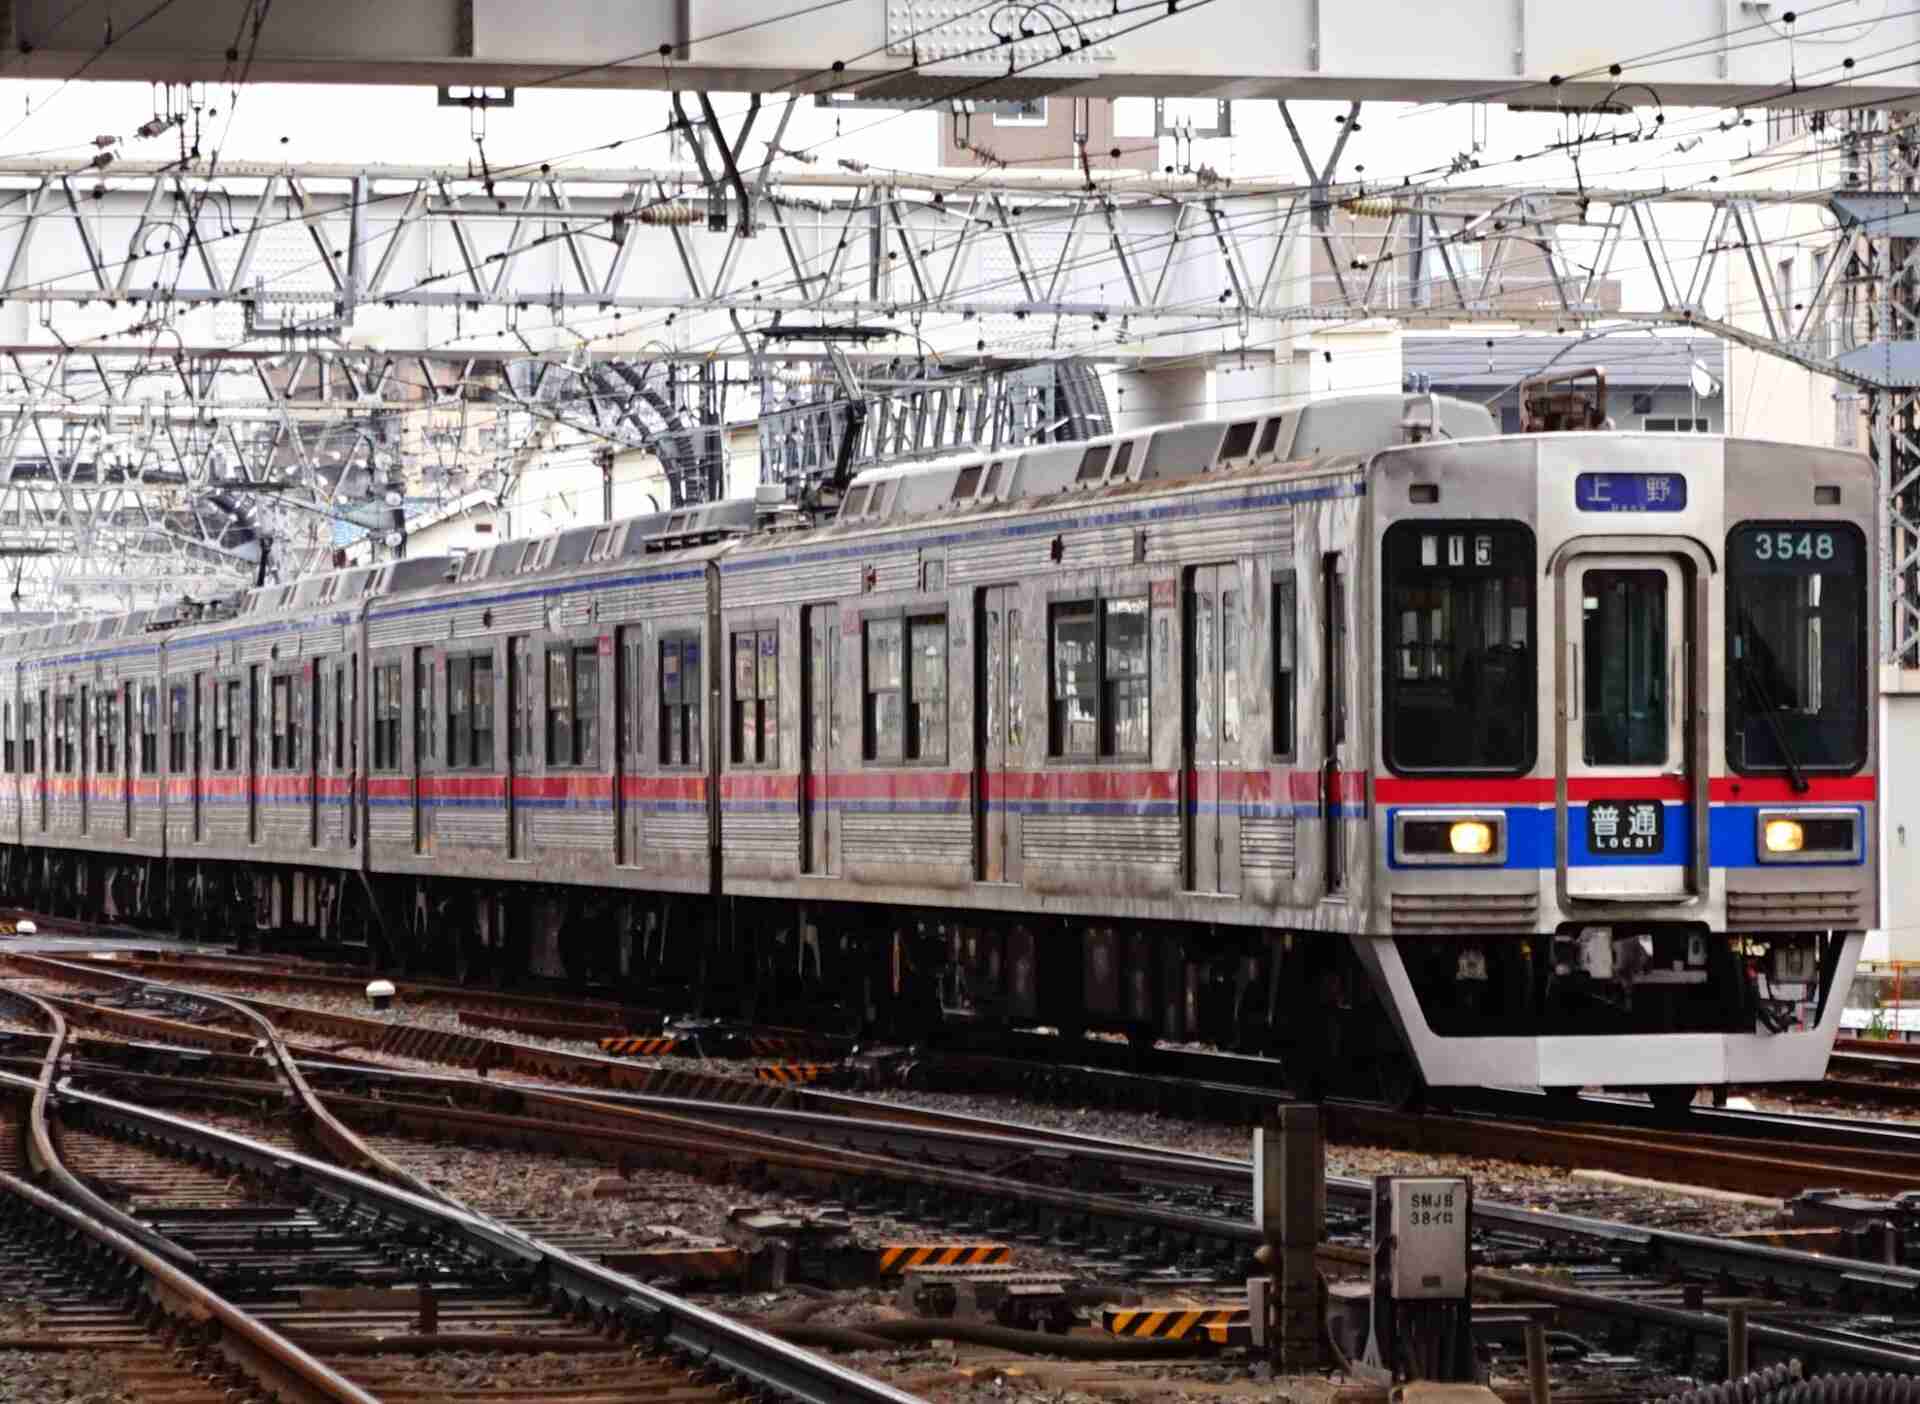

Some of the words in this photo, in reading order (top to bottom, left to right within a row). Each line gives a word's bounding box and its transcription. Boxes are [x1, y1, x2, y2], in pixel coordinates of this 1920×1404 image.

[1755, 532, 1834, 560] 3548
[1591, 805, 1657, 836] 普通
[1596, 835, 1653, 848] Local
